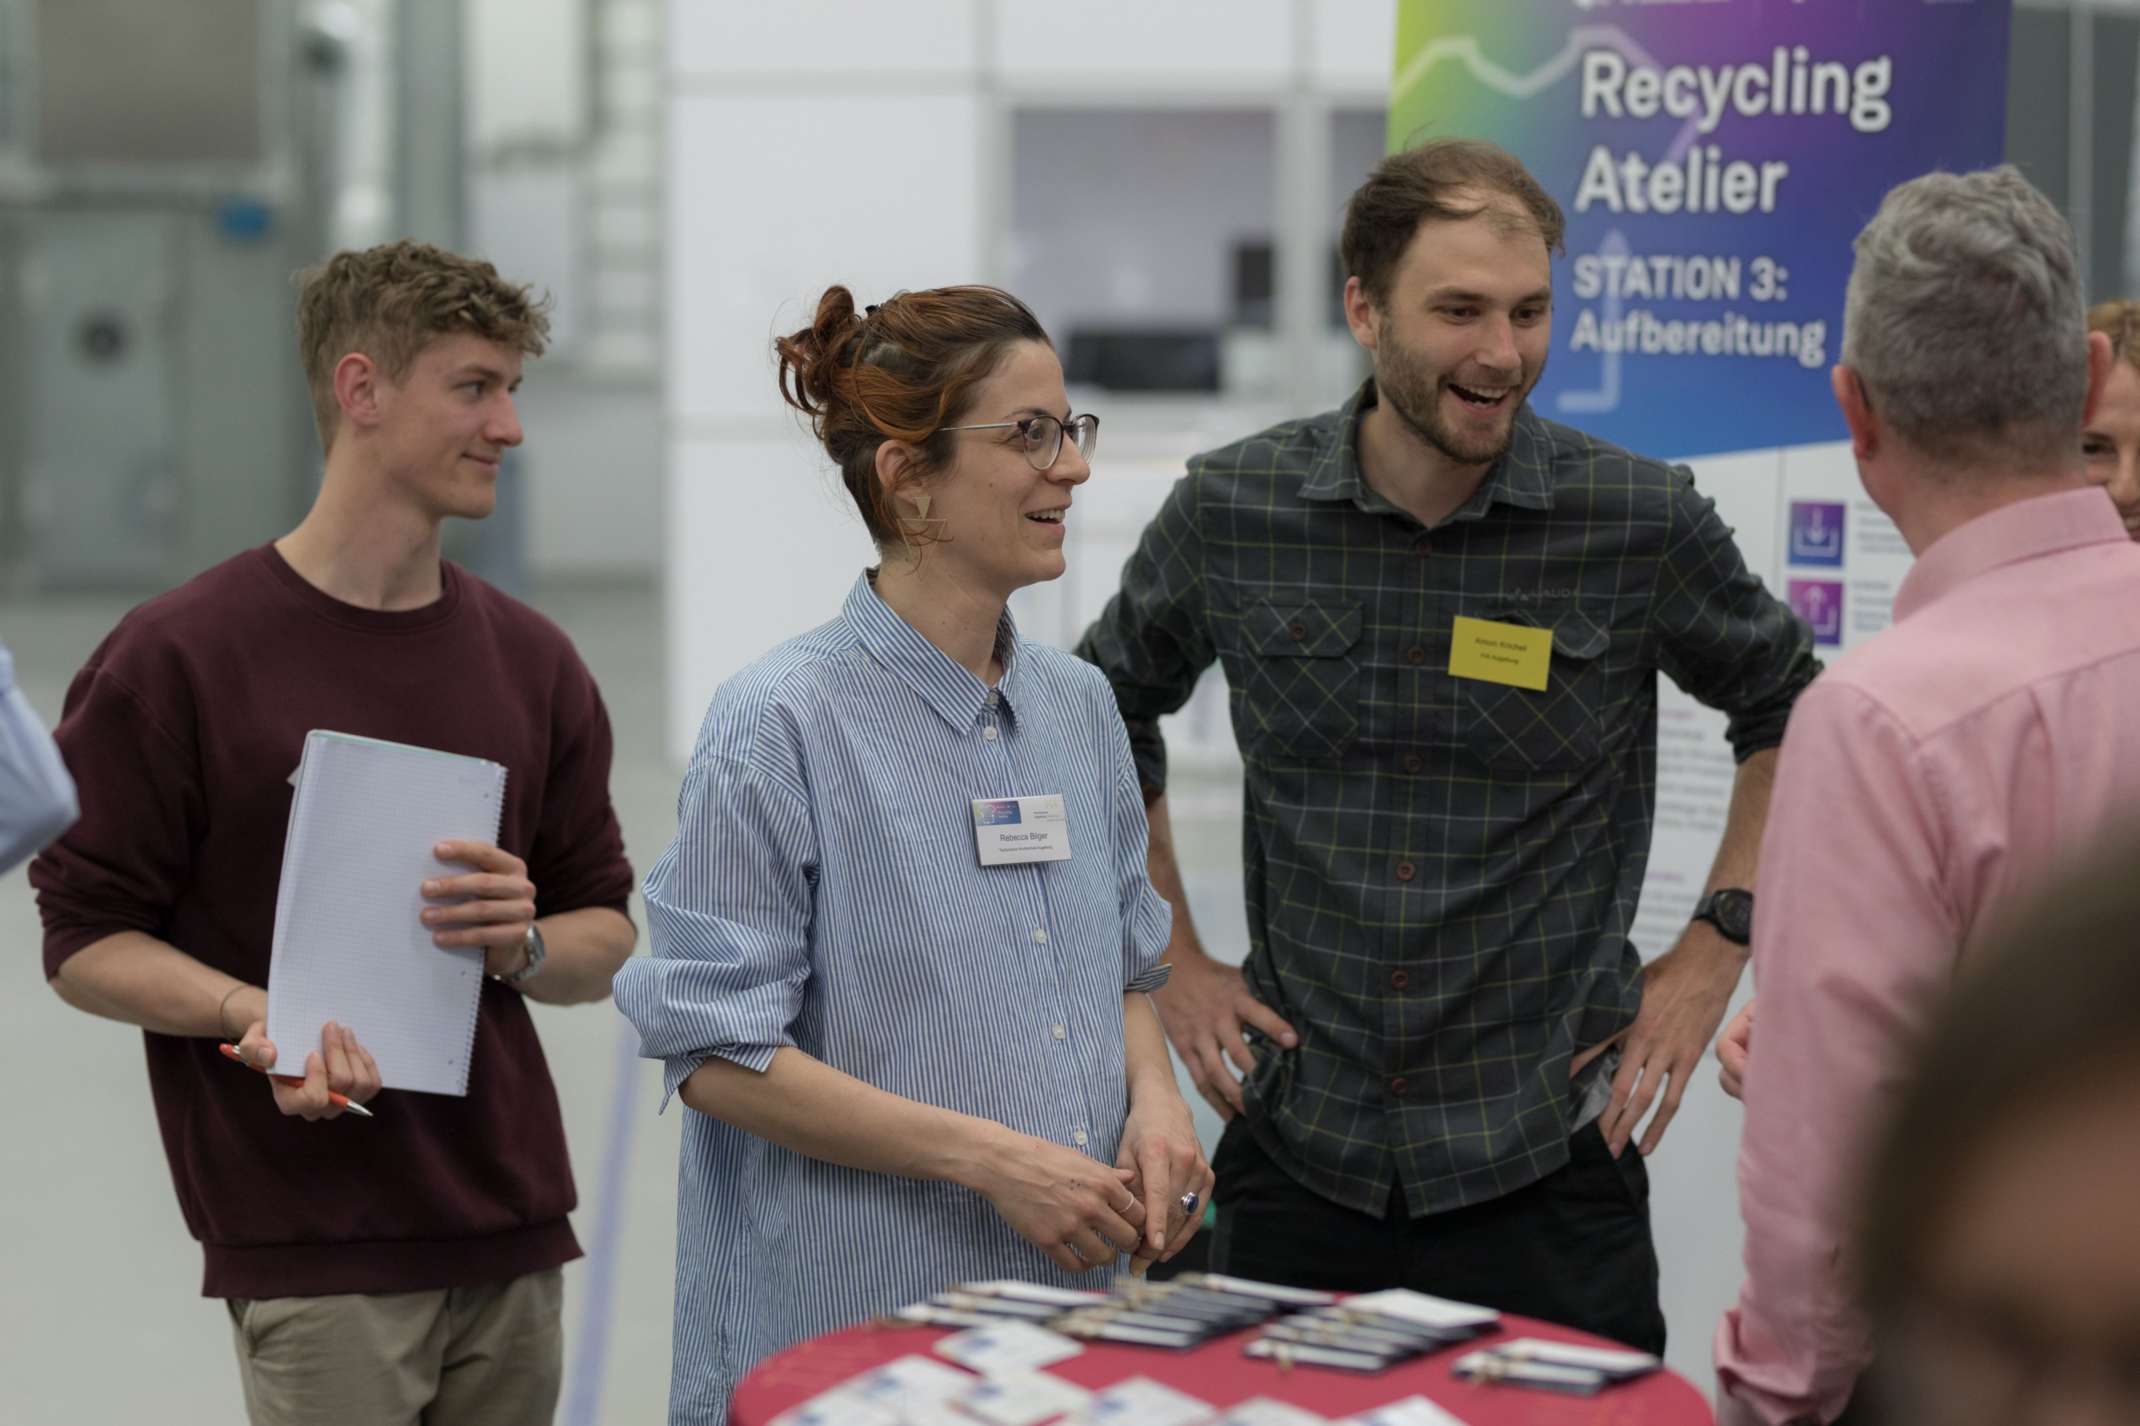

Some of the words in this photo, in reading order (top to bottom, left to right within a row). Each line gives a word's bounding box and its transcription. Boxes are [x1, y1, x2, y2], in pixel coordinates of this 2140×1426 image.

[1581, 45, 1891, 133] Recycling
[1573, 145, 1789, 214] Atelier
[1572, 254, 1741, 301] STATION
[1750, 255, 1789, 302] 3:
[1568, 307, 1827, 368] Aufbereitung
[1000, 832, 1029, 842] Rebecca
